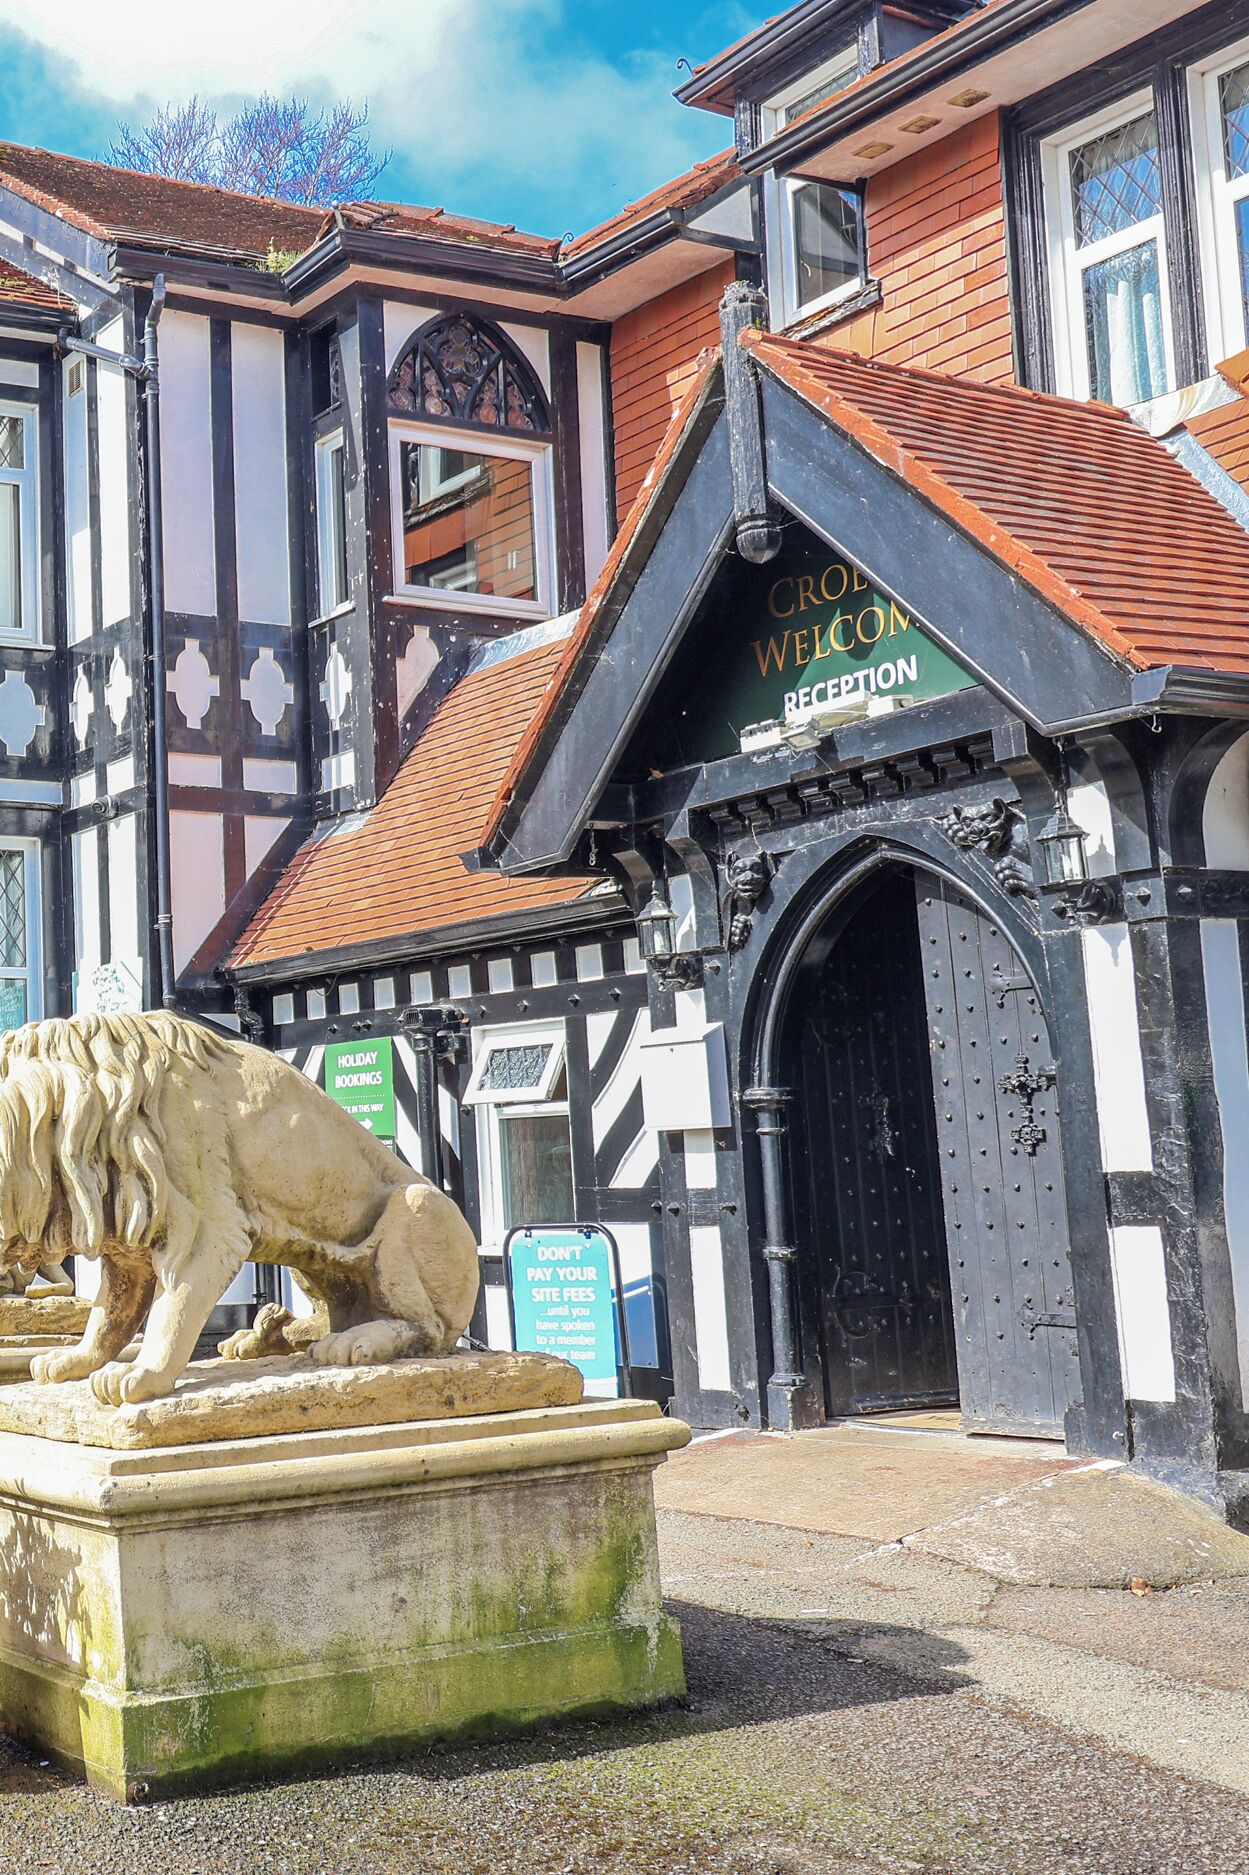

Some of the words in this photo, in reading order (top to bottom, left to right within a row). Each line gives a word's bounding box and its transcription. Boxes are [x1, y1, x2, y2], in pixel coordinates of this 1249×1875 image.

[768, 564, 869, 618] CROE
[751, 600, 920, 677] WELCOM
[784, 654, 918, 717] RECEPTION
[338, 1052, 377, 1068] HOLIDAY
[335, 1072, 382, 1088] BOOKINGS
[357, 1103, 371, 1113] THIS
[370, 1103, 384, 1112] WAY
[537, 1246, 582, 1261] DON'T
[526, 1267, 555, 1281] PAY
[557, 1266, 598, 1281] YOUR
[531, 1288, 561, 1302] SITE
[563, 1288, 596, 1302] FEES
[570, 1307, 590, 1318] you
[535, 1319, 559, 1331] have
[560, 1319, 596, 1333] spoken
[535, 1334, 548, 1345] to
[549, 1336, 556, 1345] a
[556, 1334, 596, 1346] member
[570, 1350, 595, 1360] team
